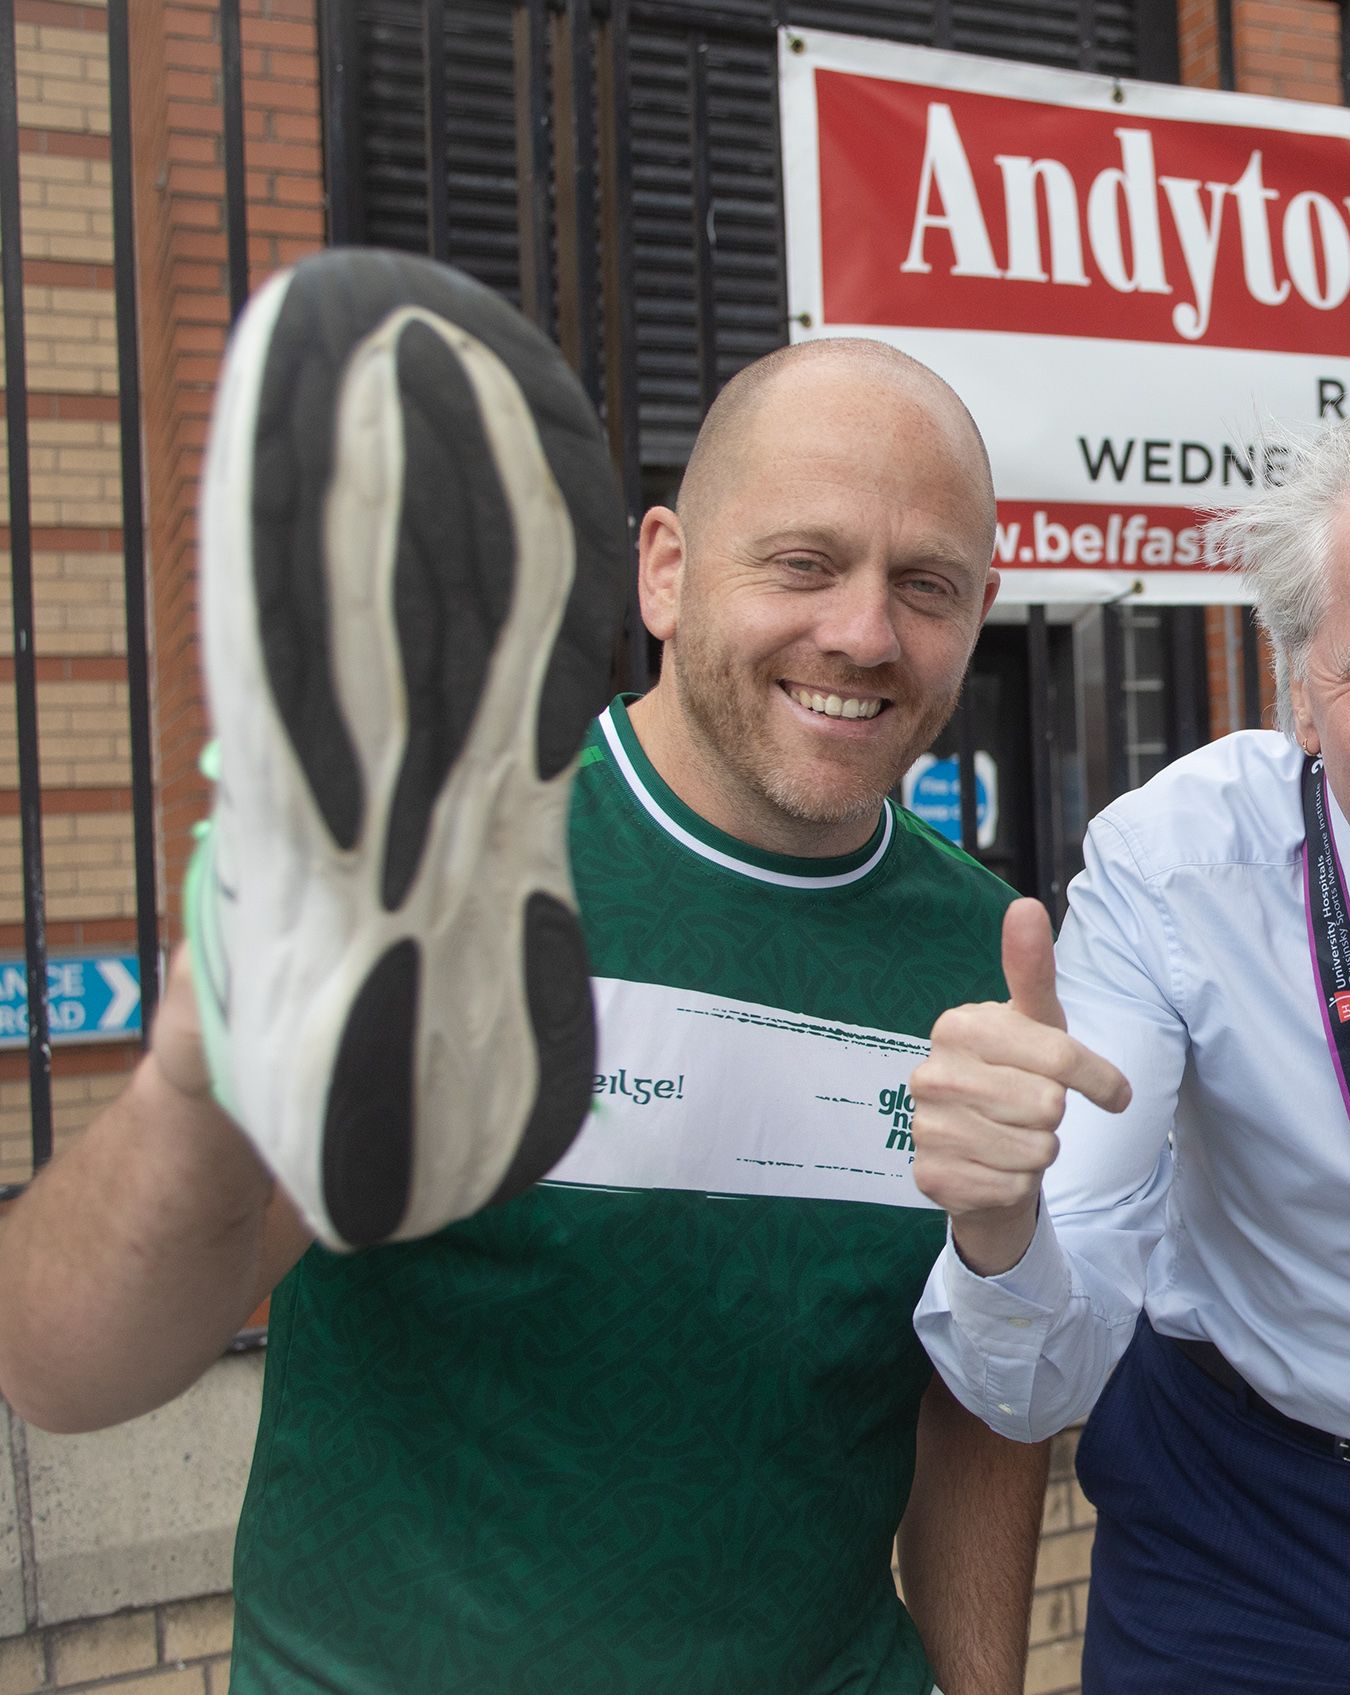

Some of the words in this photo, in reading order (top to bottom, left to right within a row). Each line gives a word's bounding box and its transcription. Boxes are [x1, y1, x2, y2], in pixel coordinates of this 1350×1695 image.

[1079, 436, 1289, 488] WEDNE
[1315, 783, 1326, 830] Institute
[1322, 832, 1336, 885] Medicine
[1317, 854, 1332, 918] Hospitals
[1331, 887, 1344, 925] Sports
[1327, 921, 1346, 989] University
[592, 1068, 685, 1105] eilge!
[878, 1083, 916, 1115] glo
